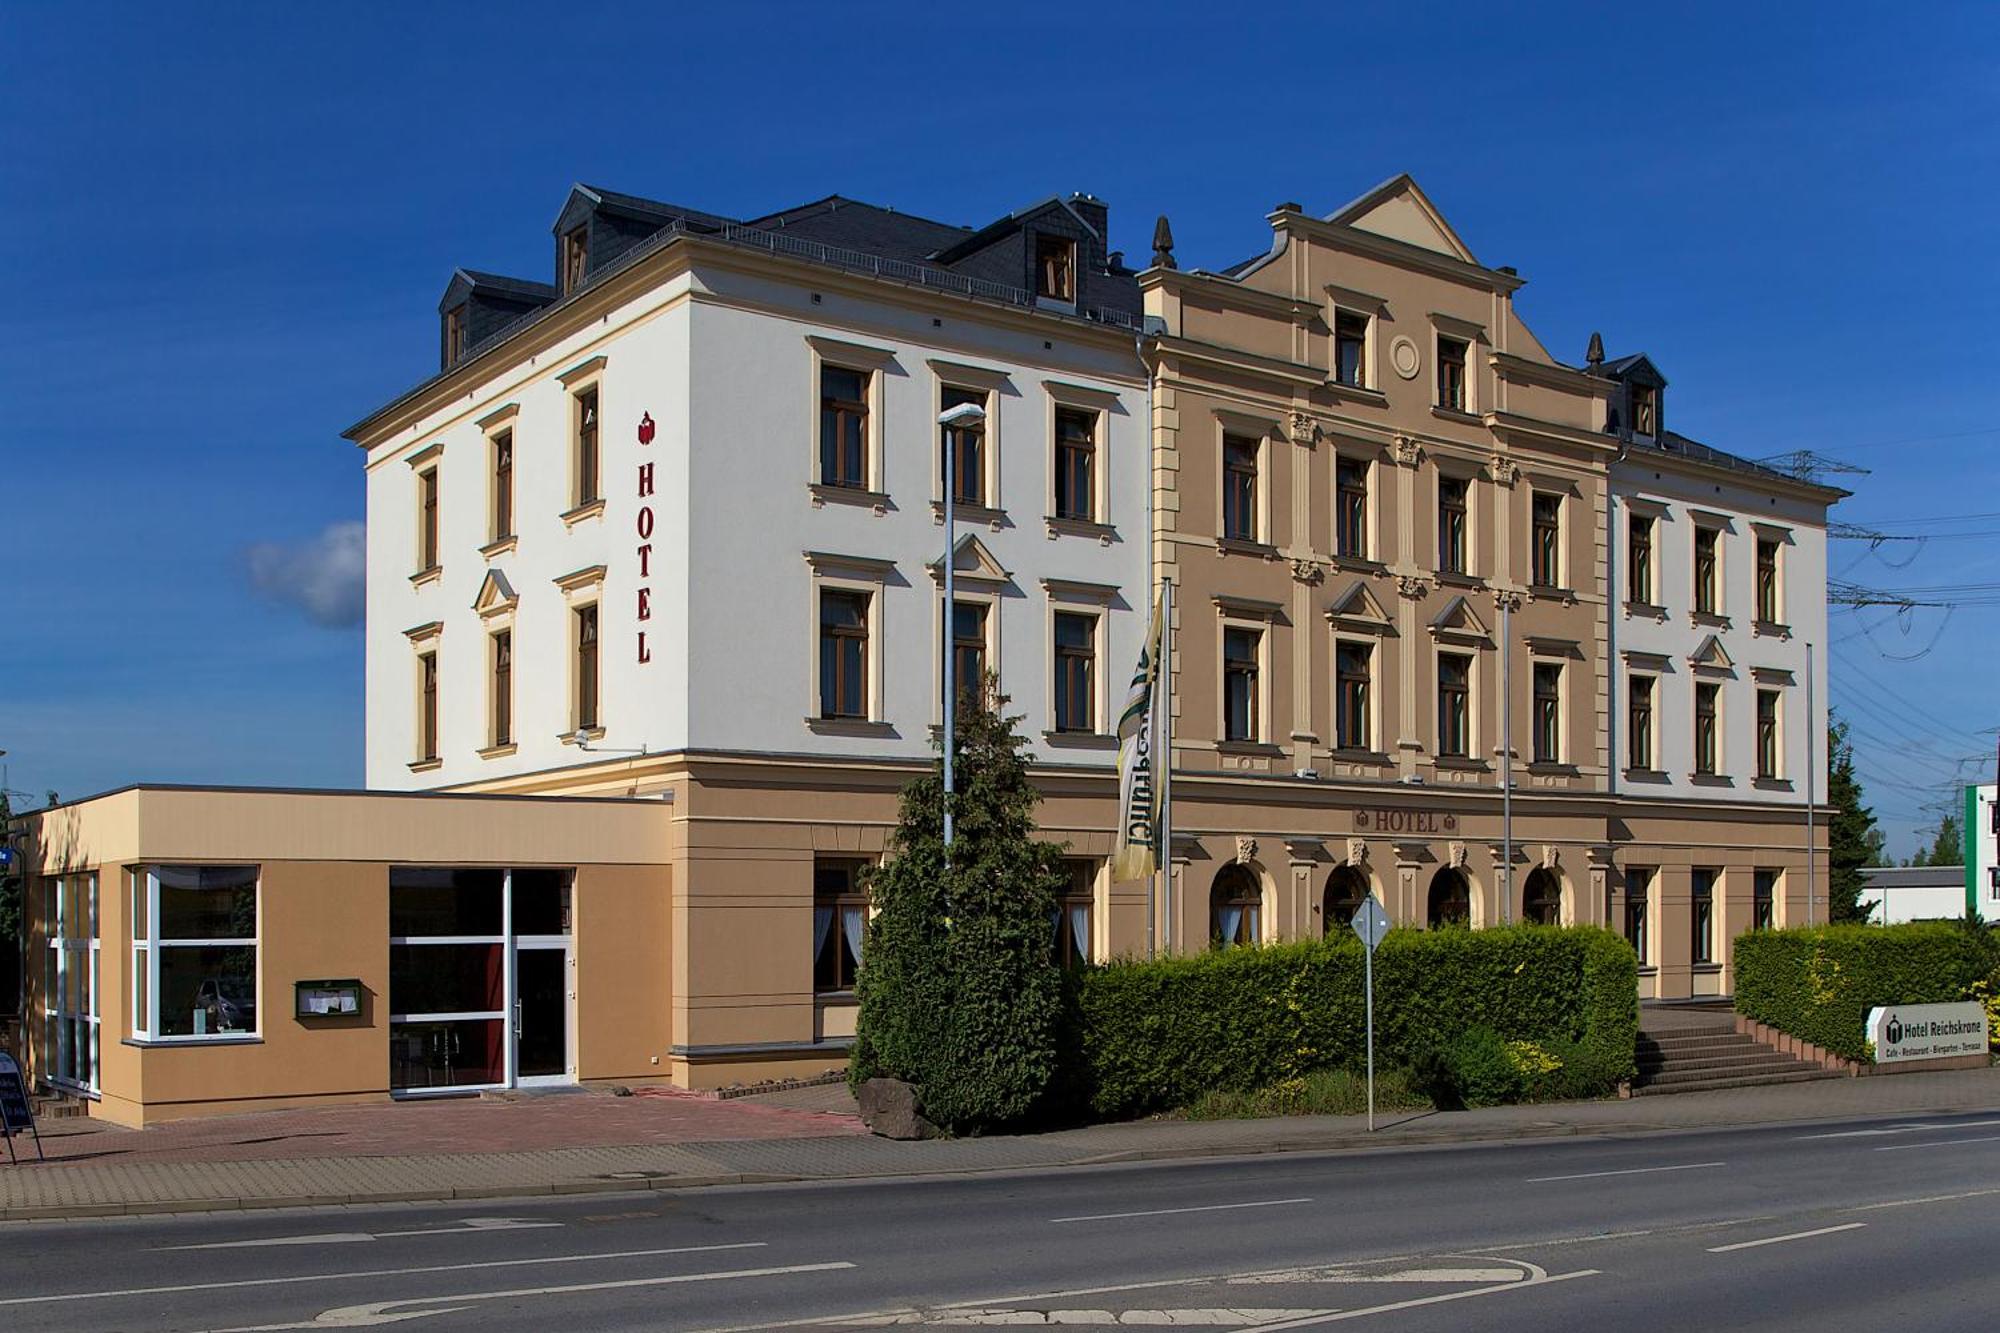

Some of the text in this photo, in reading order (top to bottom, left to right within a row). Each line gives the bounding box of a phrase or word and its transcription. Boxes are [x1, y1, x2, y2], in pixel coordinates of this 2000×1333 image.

[637, 462, 654, 664] HOTEL
[1376, 810, 1438, 832] HOTEL
[1904, 1020, 1981, 1038] Hotel Reichskrone
